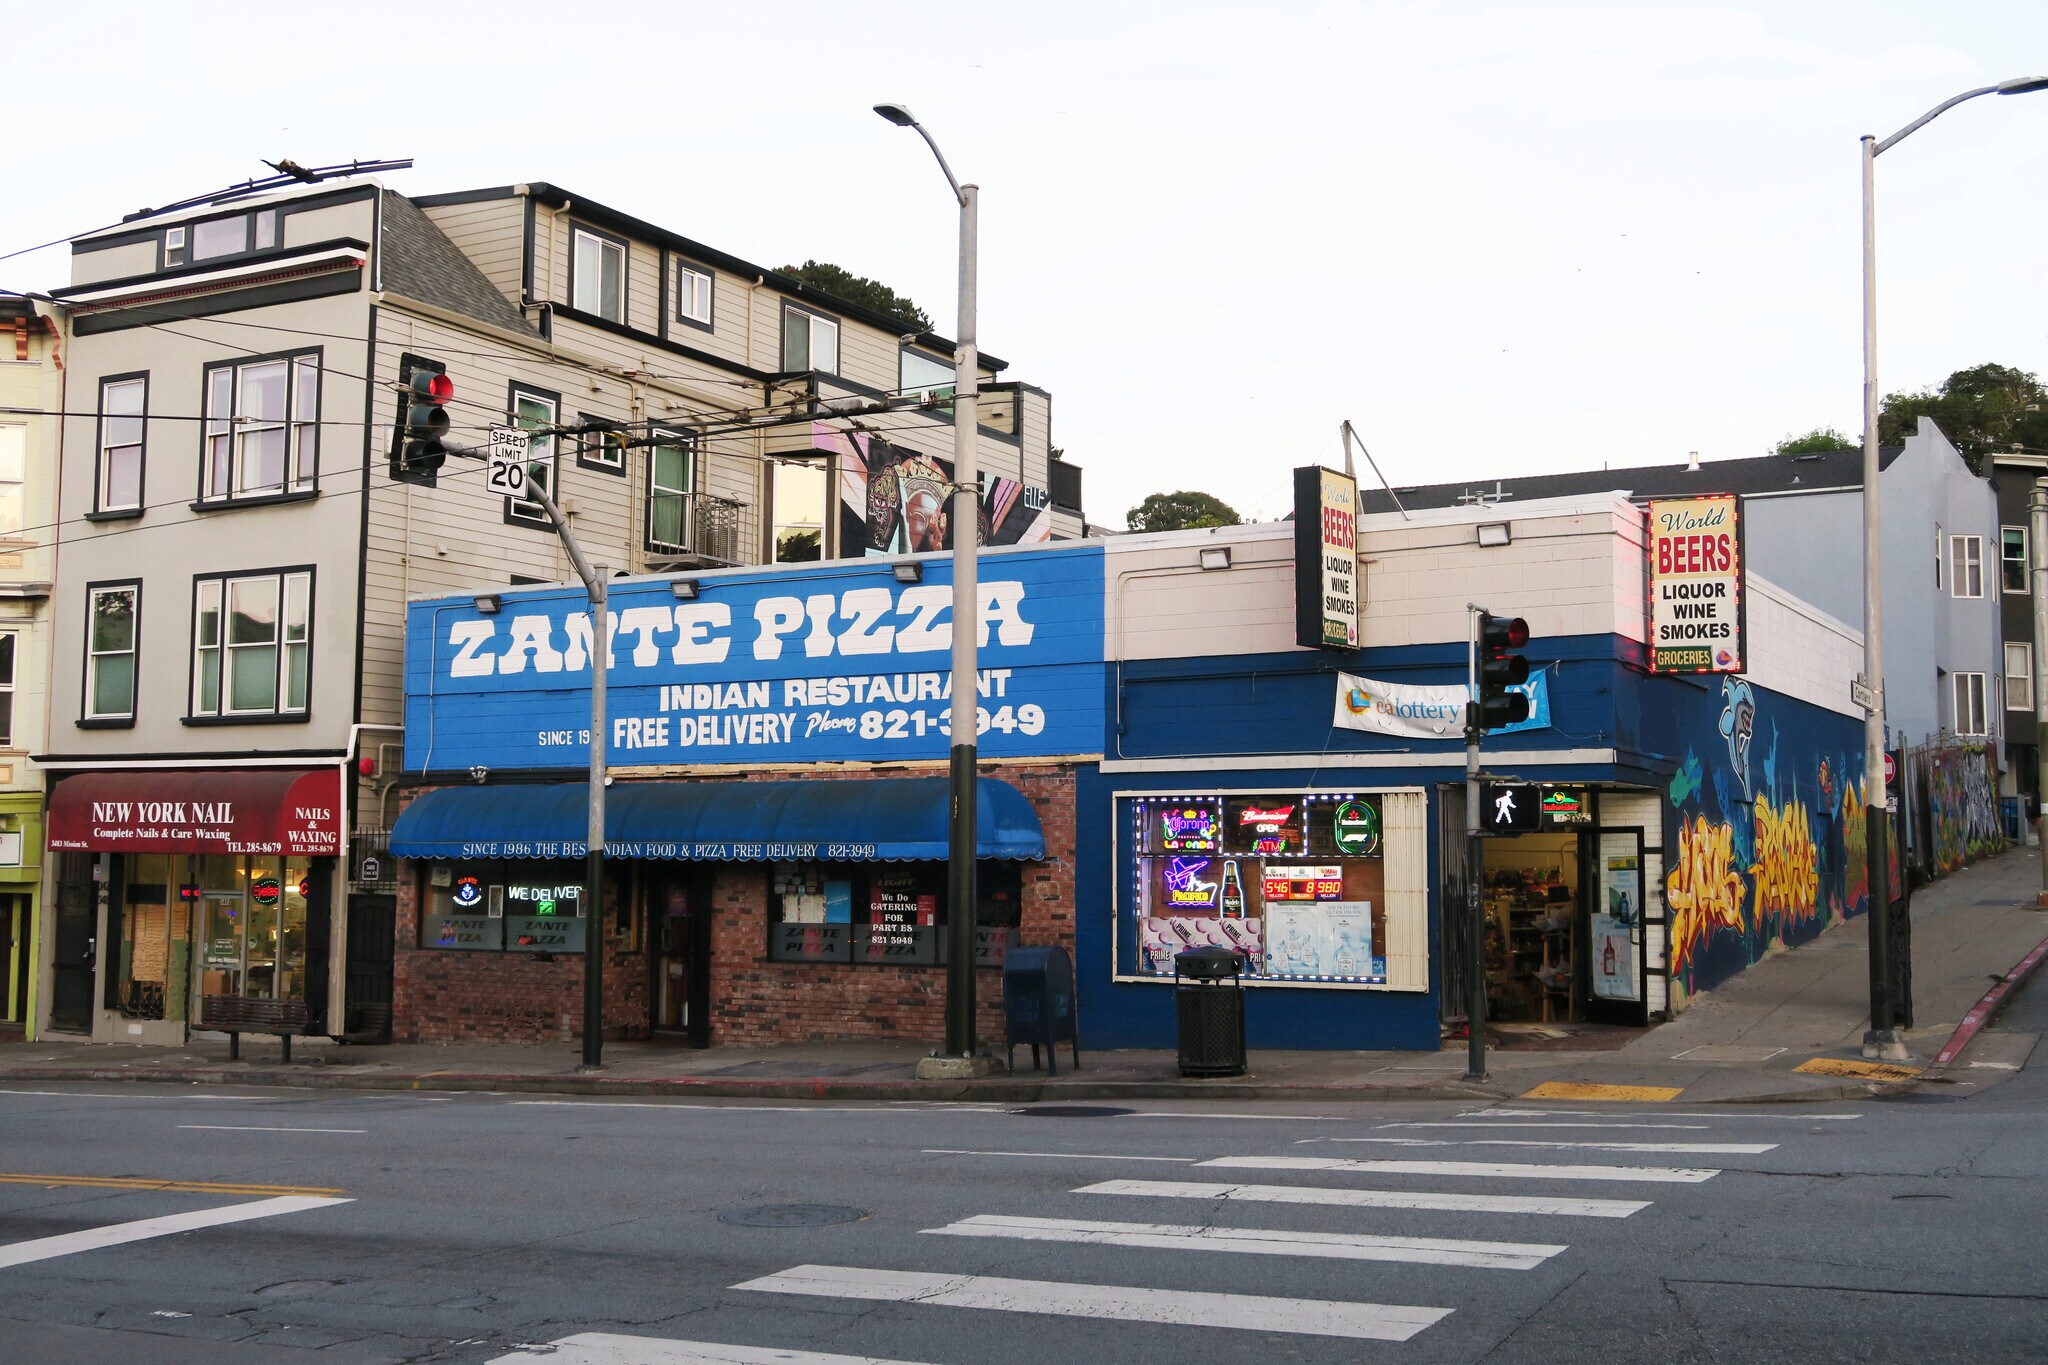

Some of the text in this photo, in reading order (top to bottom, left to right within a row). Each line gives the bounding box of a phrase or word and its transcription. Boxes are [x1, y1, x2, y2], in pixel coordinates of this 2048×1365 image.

[492, 431, 527, 448] SPEED
[495, 447, 522, 461] LIMIT
[491, 461, 523, 489] 20
[1324, 483, 1351, 504] World
[1324, 506, 1354, 550] BEERS
[1660, 507, 1726, 533] World
[1658, 533, 1731, 574] BEERS
[1326, 555, 1353, 576] LIQUOR
[1331, 576, 1349, 595] WINE
[1662, 582, 1726, 600] LIQUOR
[1325, 595, 1355, 616] SMOKES
[1673, 603, 1716, 620] WINE
[448, 581, 1035, 678] ZANTE PIZZA
[1660, 622, 1730, 640] SMOKES
[1657, 649, 1711, 665] GROCERIES
[660, 680, 770, 712] INDIAN
[1376, 697, 1462, 724] calottery
[538, 729, 590, 746] SINCE 19
[613, 717, 669, 750] FREE
[680, 712, 796, 748] DELIVERY
[805, 709, 856, 739] Phone
[92, 802, 234, 824] NEW YORK NAIL
[295, 807, 331, 820] NAILS
[307, 819, 318, 829] &
[1169, 817, 1210, 832] Corona
[1256, 824, 1279, 833] OPEN
[94, 827, 231, 842] Complete Nails & Care Waxing
[288, 831, 337, 843] WAXING
[227, 842, 282, 853] TEL. 285-8679
[291, 844, 334, 853] TEL. 285-8679
[462, 843, 876, 857] SINCE 1986 THE BES NDIAN FOOD & PIZZA FREE DELIVERY 821-3949
[508, 886, 529, 900] WE
[1266, 882, 1288, 893] 546
[1306, 882, 1315, 893] 8
[1317, 882, 1341, 893] 980
[525, 921, 571, 931] ZANTE
[885, 914, 904, 922] FOR
[975, 932, 1010, 942] NTE
[1175, 923, 1192, 939] PRIME
[1225, 923, 1242, 941] PRIME
[871, 936, 913, 944] 821 3949
[1150, 950, 1171, 961] PRIME
